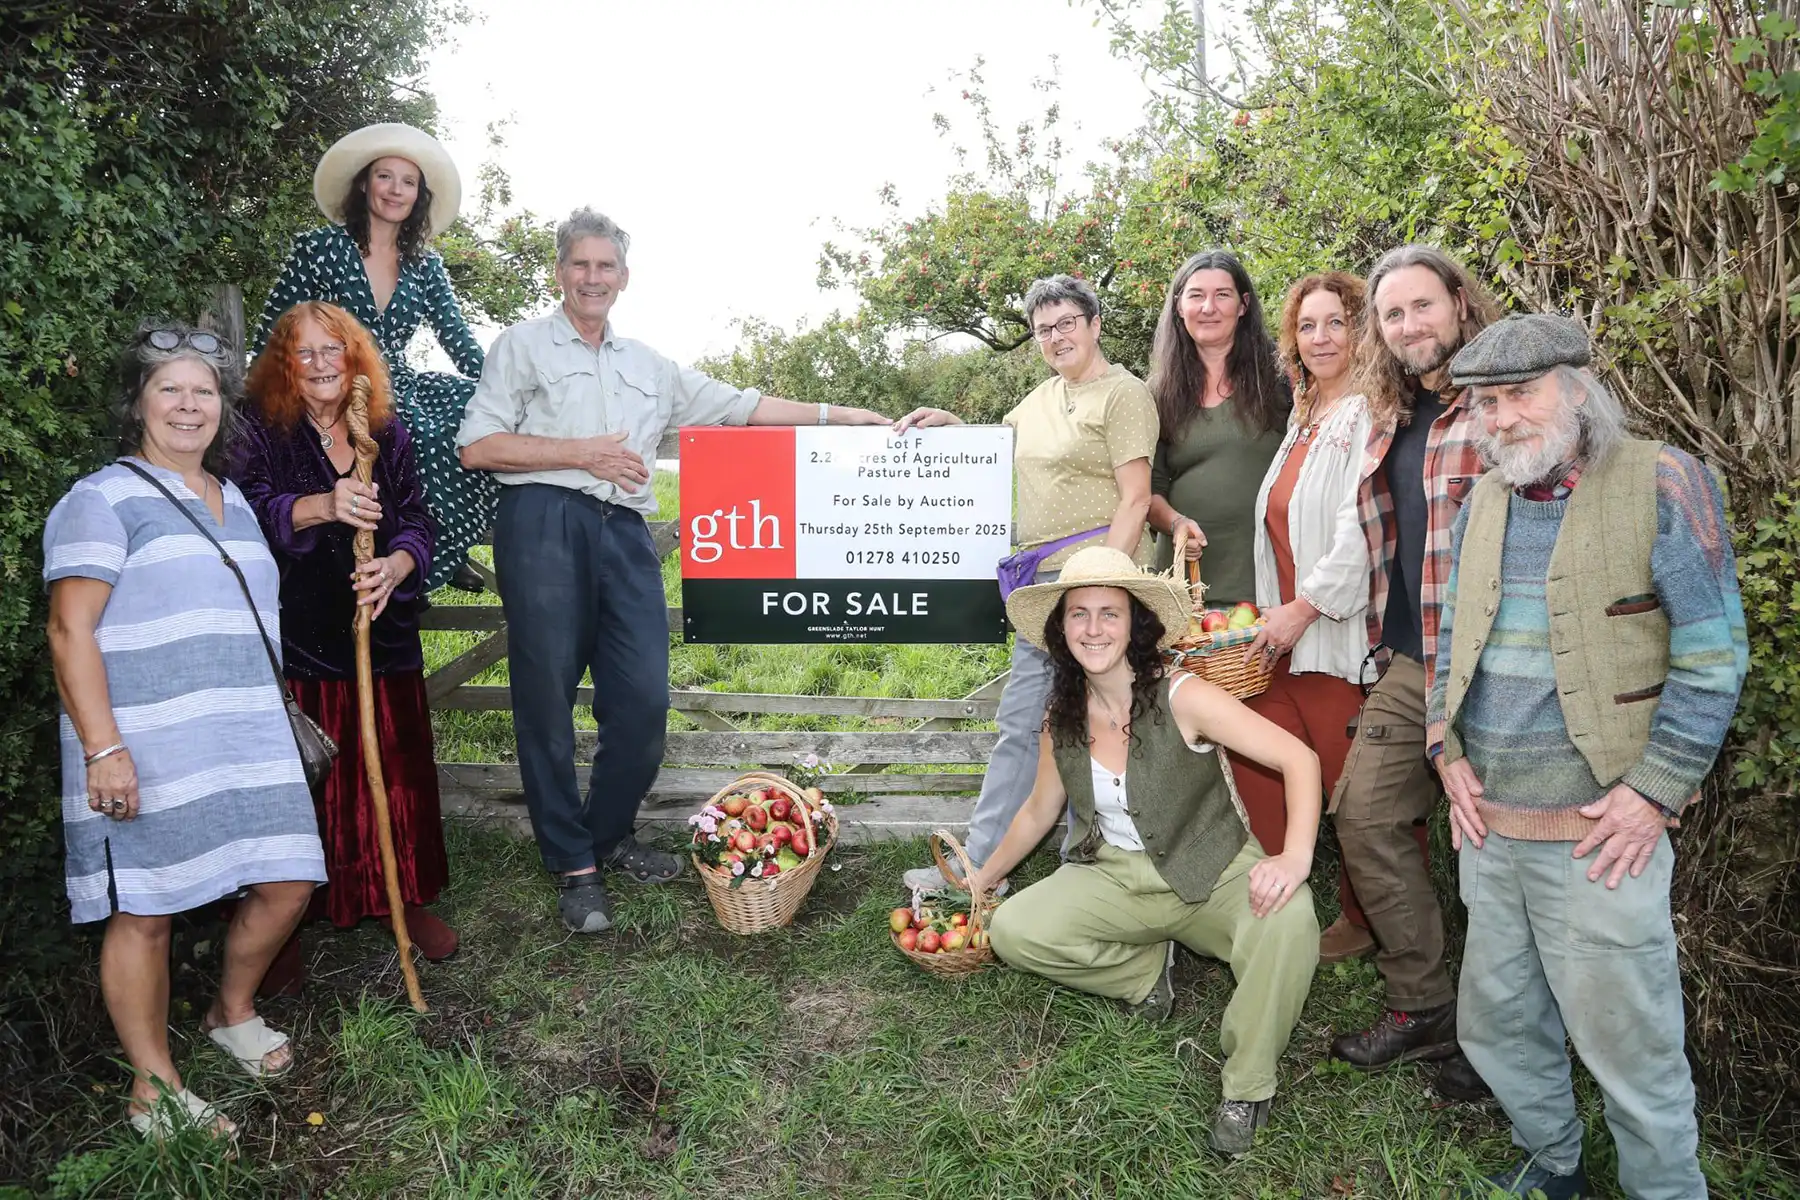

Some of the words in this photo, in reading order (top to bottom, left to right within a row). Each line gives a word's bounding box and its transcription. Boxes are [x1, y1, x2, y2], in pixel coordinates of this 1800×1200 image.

[886, 437, 909, 449] Lot
[915, 437, 923, 449] F
[893, 451, 907, 464] of
[913, 451, 997, 467] Agricultural
[858, 466, 911, 478] Pasture
[917, 466, 950, 478] Land
[833, 495, 856, 506] For
[862, 495, 892, 507] Sale
[898, 495, 914, 509] by
[920, 496, 974, 507] Auction
[690, 500, 785, 563] gth
[800, 523, 859, 537] Thursday
[864, 523, 893, 535] 25th
[899, 523, 970, 537] September
[975, 524, 1007, 536] 2025
[846, 551, 895, 565] 01278
[902, 551, 960, 565] 410250
[763, 592, 831, 615] FOR
[846, 592, 929, 615] SALE
